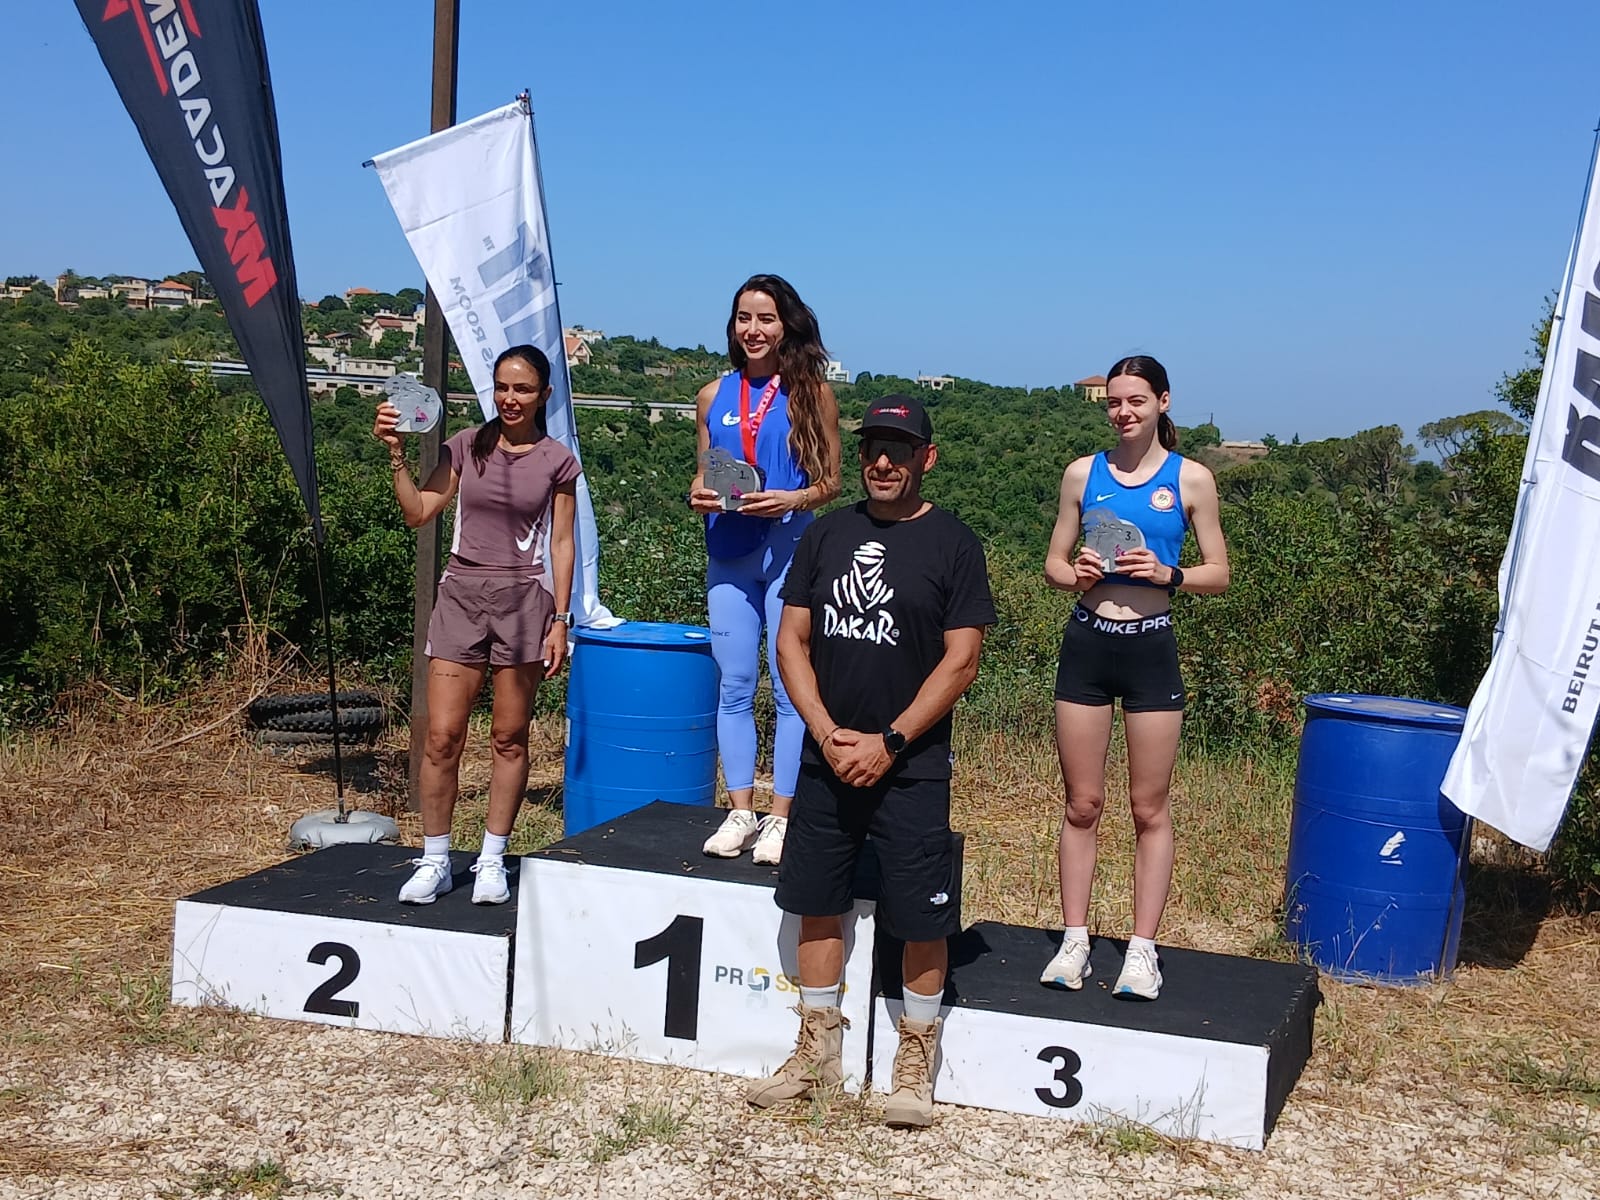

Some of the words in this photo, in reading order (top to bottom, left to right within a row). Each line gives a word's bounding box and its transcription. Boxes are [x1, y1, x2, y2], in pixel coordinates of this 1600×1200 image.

[823, 603, 898, 646] DAKAR
[1093, 618, 1140, 635] NIKE
[1561, 618, 1600, 715] BEIRUT
[303, 941, 361, 1018] 2
[634, 914, 704, 1041] 1
[1034, 1045, 1083, 1109] 3
